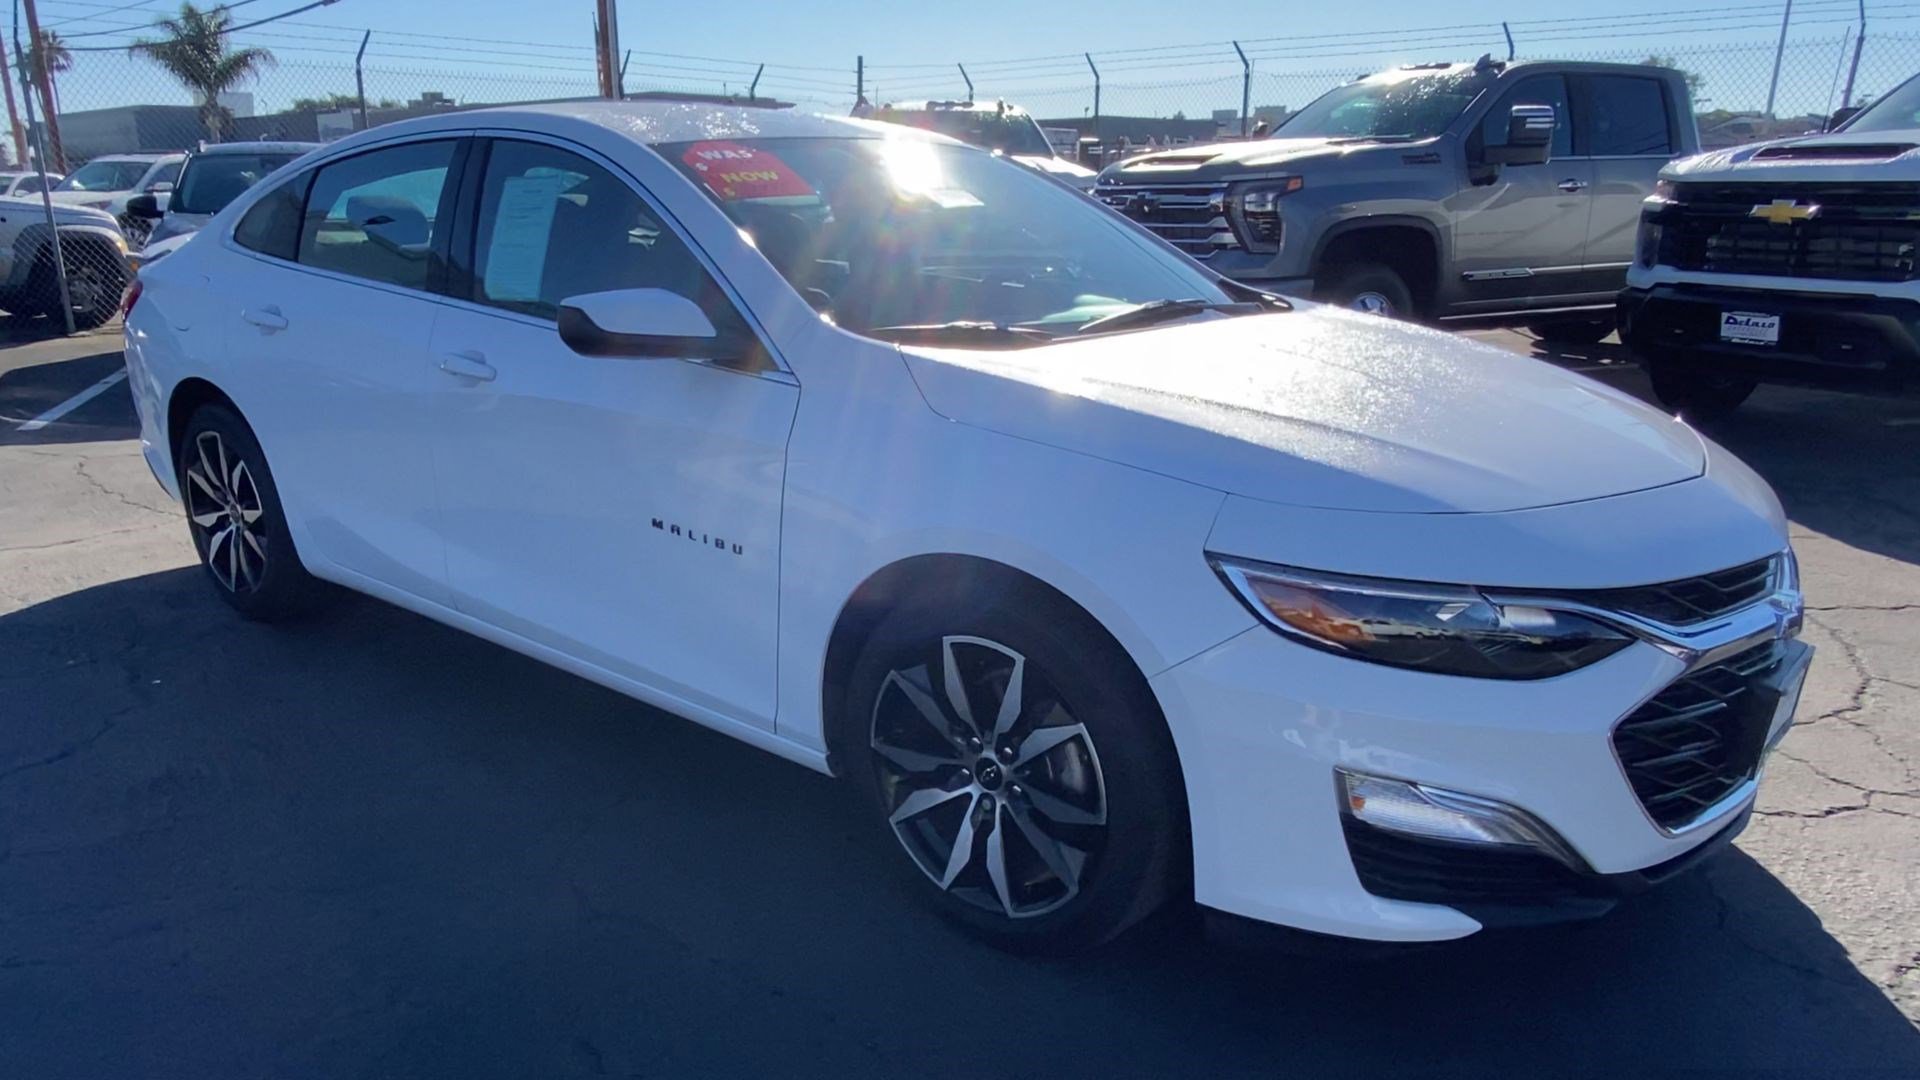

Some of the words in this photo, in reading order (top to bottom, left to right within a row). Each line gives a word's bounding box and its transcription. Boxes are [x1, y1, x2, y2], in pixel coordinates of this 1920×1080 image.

[696, 150, 753, 160] WAS
[720, 171, 779, 183] NOW
[651, 517, 744, 556] MALIBU
